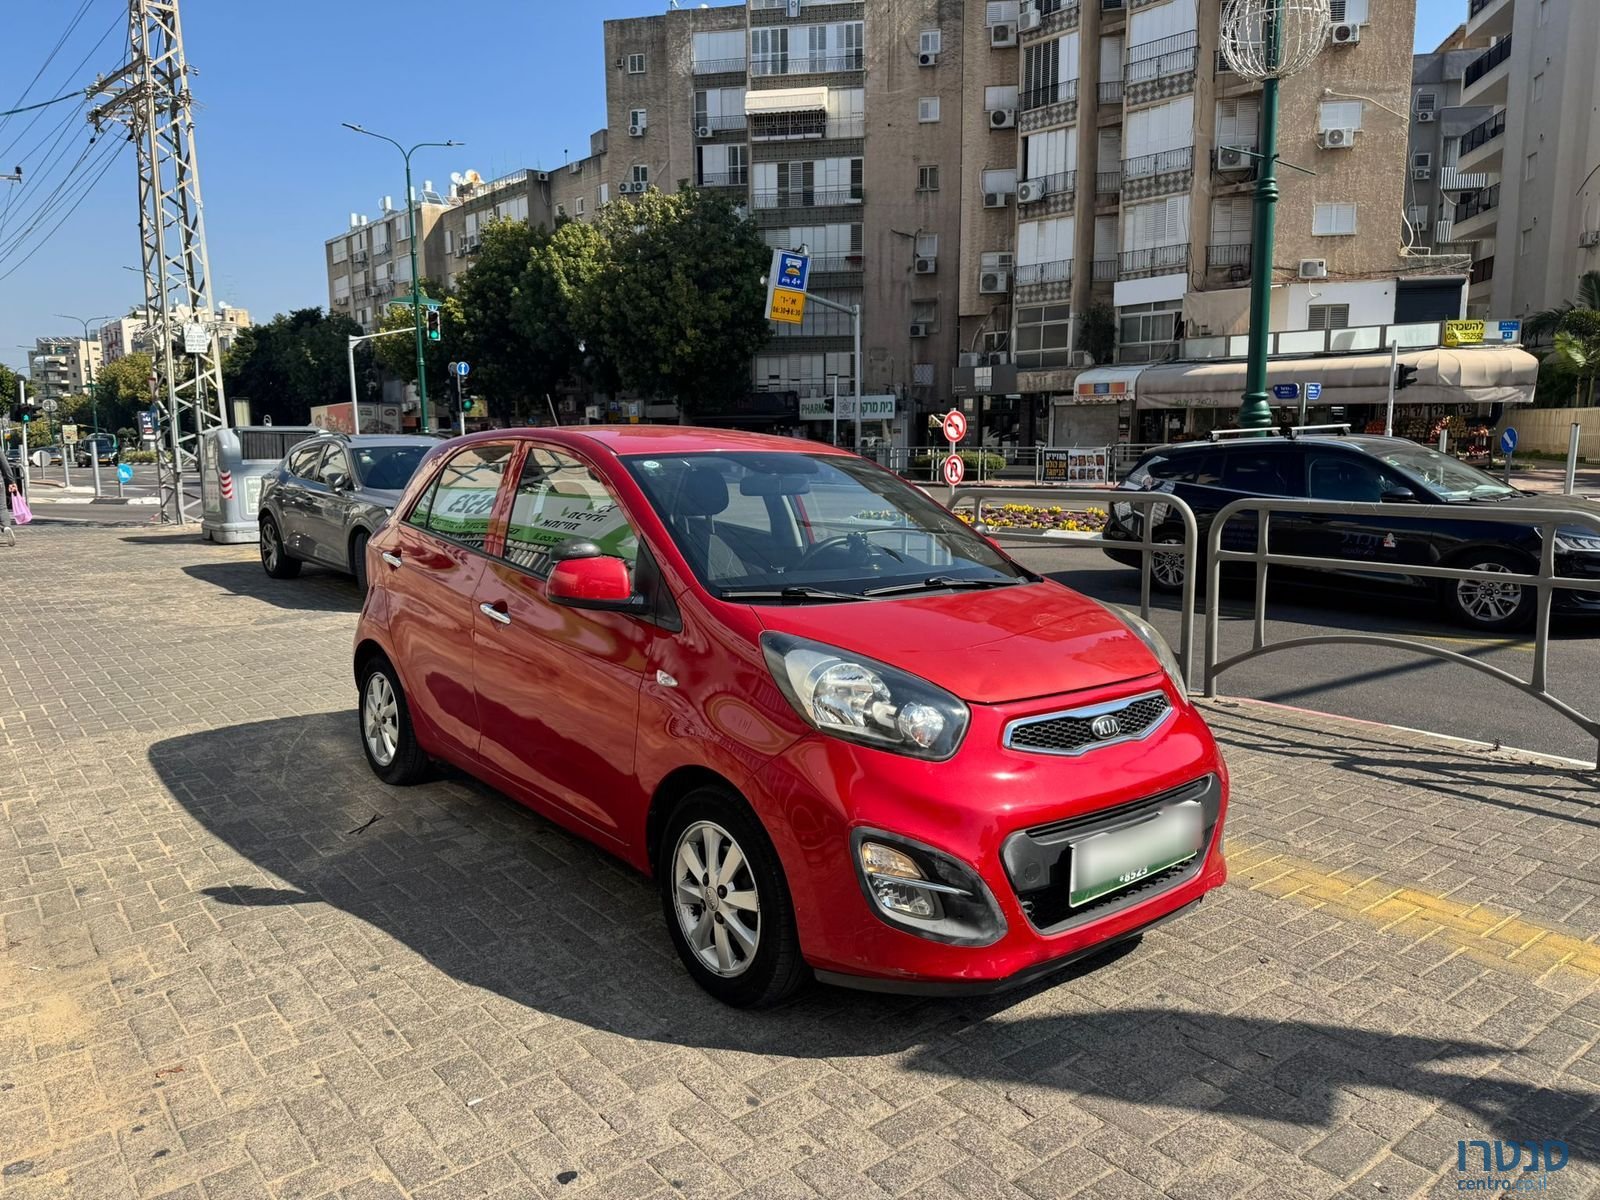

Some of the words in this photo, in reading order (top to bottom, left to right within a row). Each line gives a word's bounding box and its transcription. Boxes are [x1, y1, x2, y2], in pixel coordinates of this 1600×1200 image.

[1447, 321, 1484, 331] להשכרה
[852, 401, 878, 417] מרקת
[880, 401, 893, 413] בית
[1099, 719, 1119, 735] KIA
